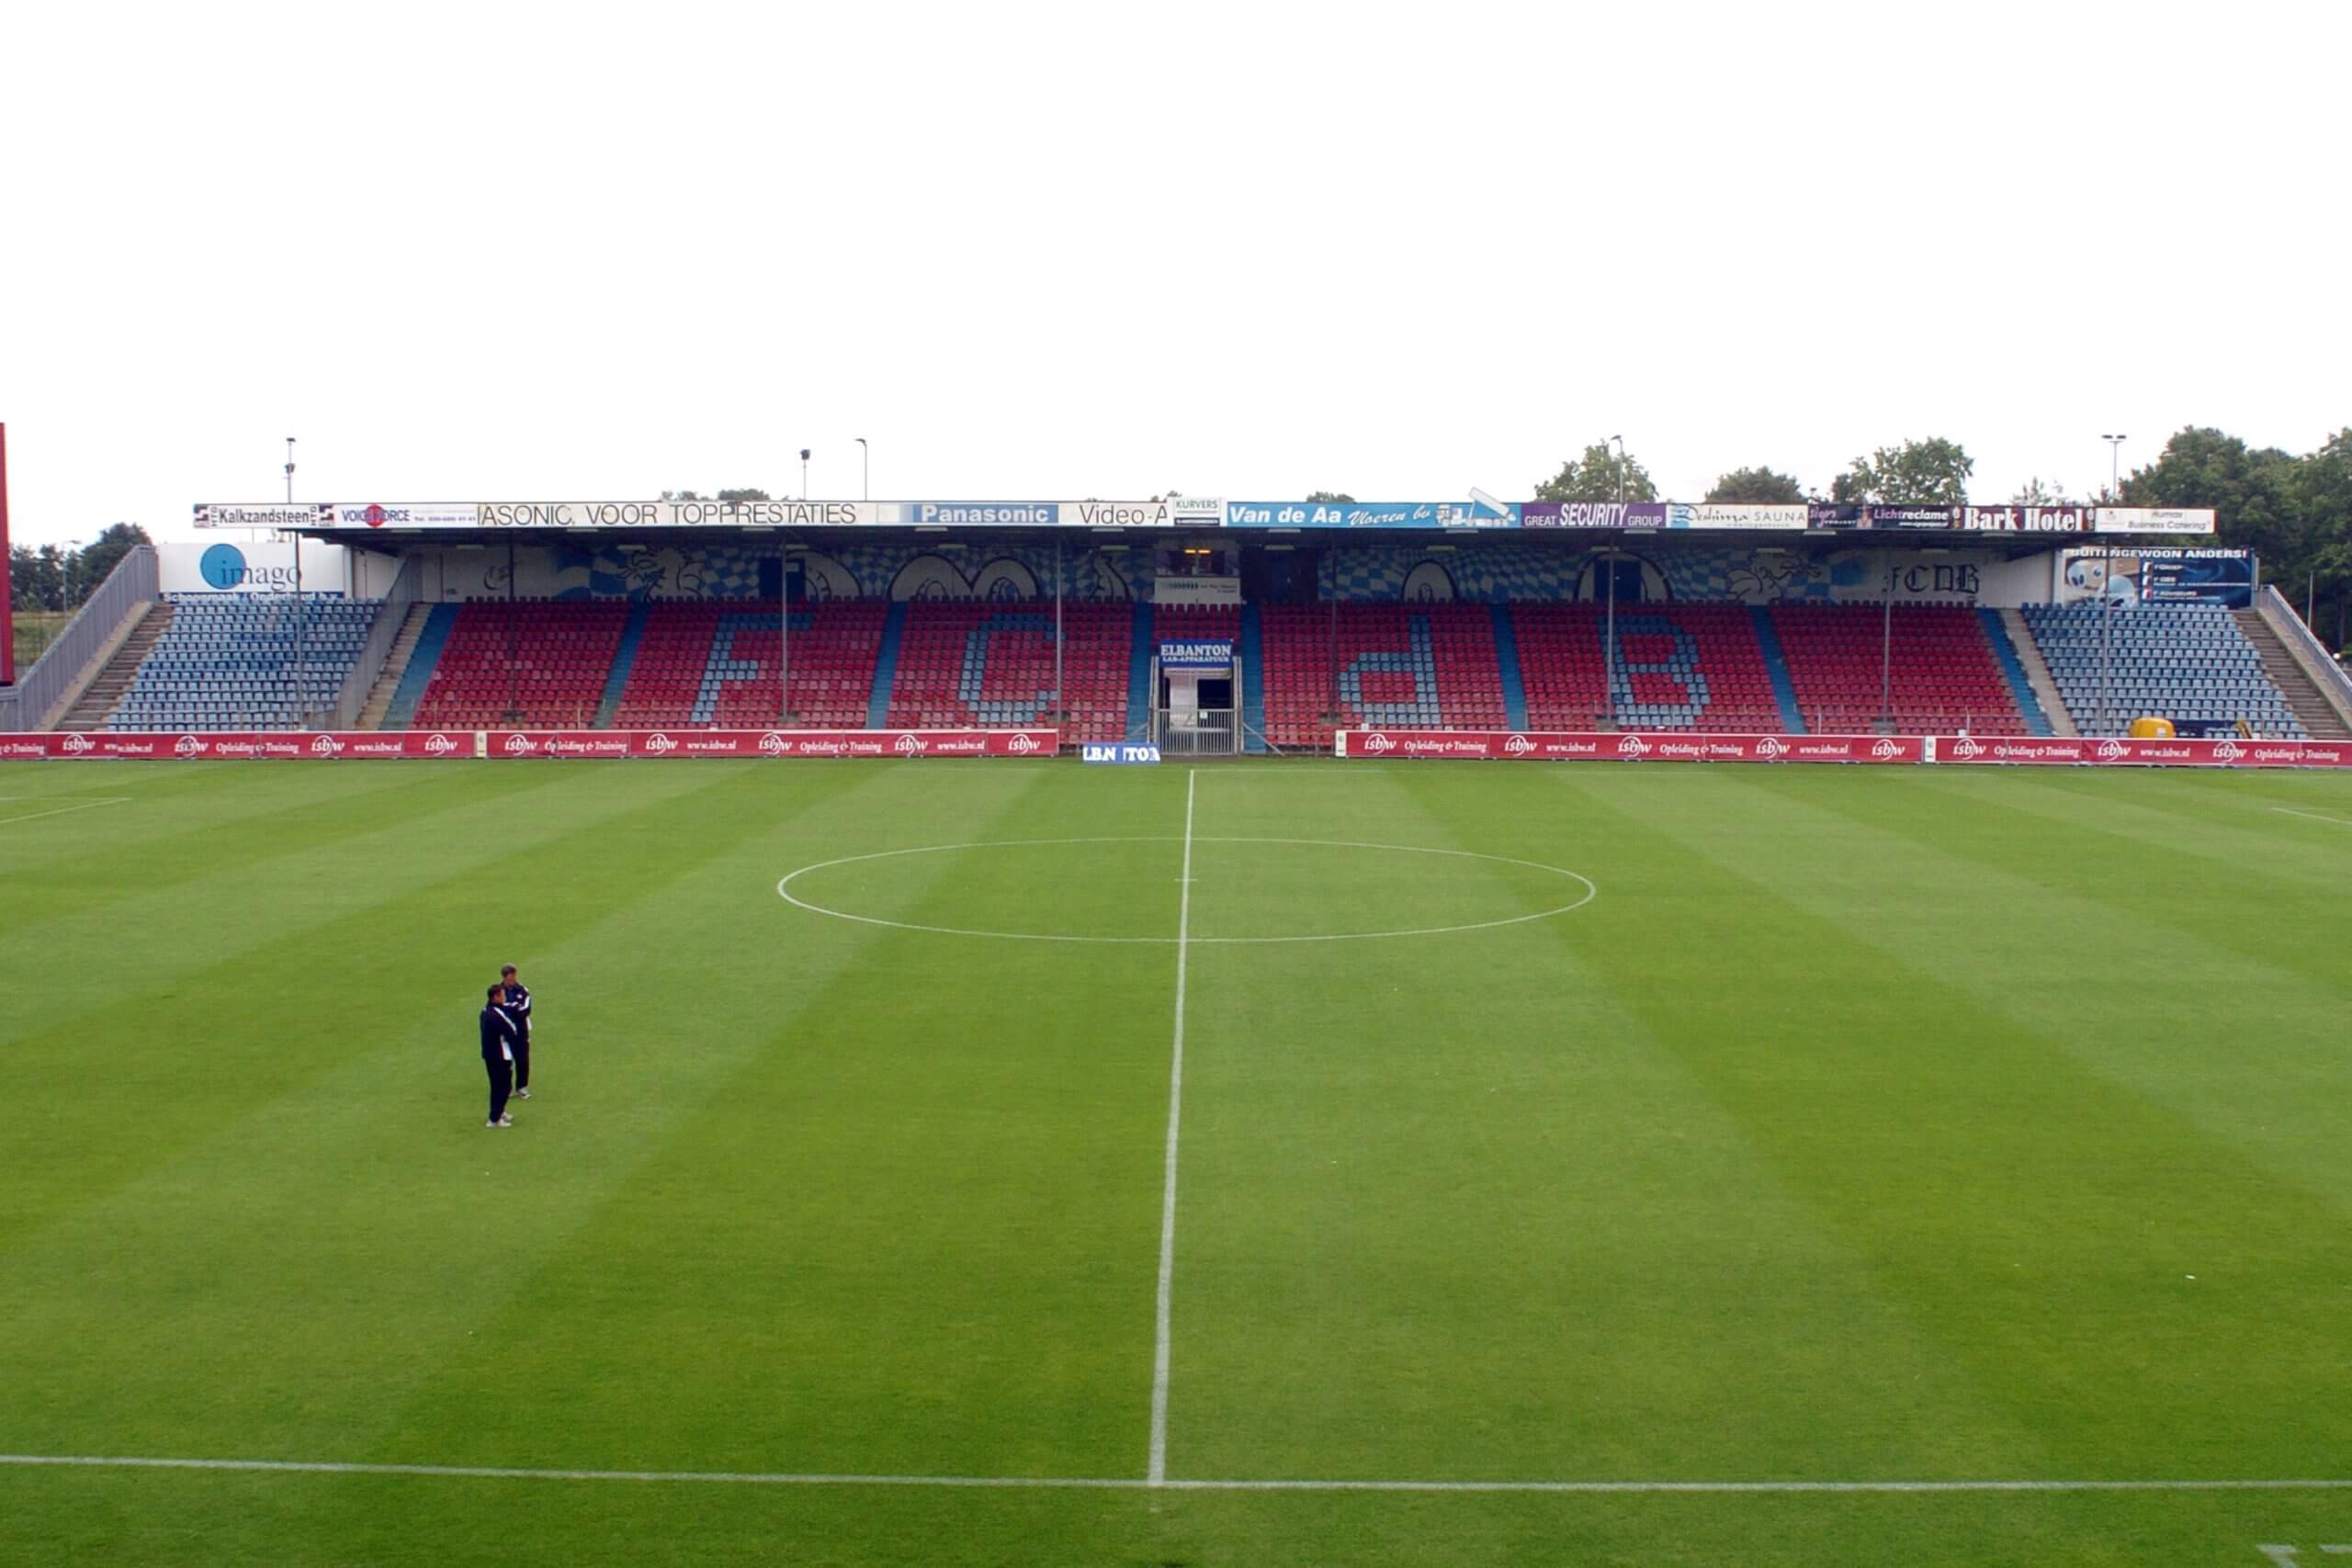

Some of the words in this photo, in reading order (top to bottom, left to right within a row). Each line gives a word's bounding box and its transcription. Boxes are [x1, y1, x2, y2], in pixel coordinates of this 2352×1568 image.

[220, 509, 309, 524] Kalkzandsteen
[586, 505, 658, 525] VOOR
[673, 504, 856, 525] TOPPRESTATIES
[922, 504, 1048, 523] Panasonic
[1230, 506, 1271, 523] Van
[1278, 507, 1305, 523] de
[1311, 507, 1341, 523] Aa
[1524, 515, 1556, 526] GREAT
[1559, 503, 1627, 526] SECURITY
[1627, 515, 1662, 526] GROUP
[1754, 511, 1805, 522] SAUNA
[1873, 508, 1949, 520] Lichtreclame
[2024, 507, 2083, 531] Hotel
[2073, 548, 2181, 558] BUITNGEWOON
[220, 558, 301, 591] imago
[1161, 644, 1231, 656] ELBANTON
